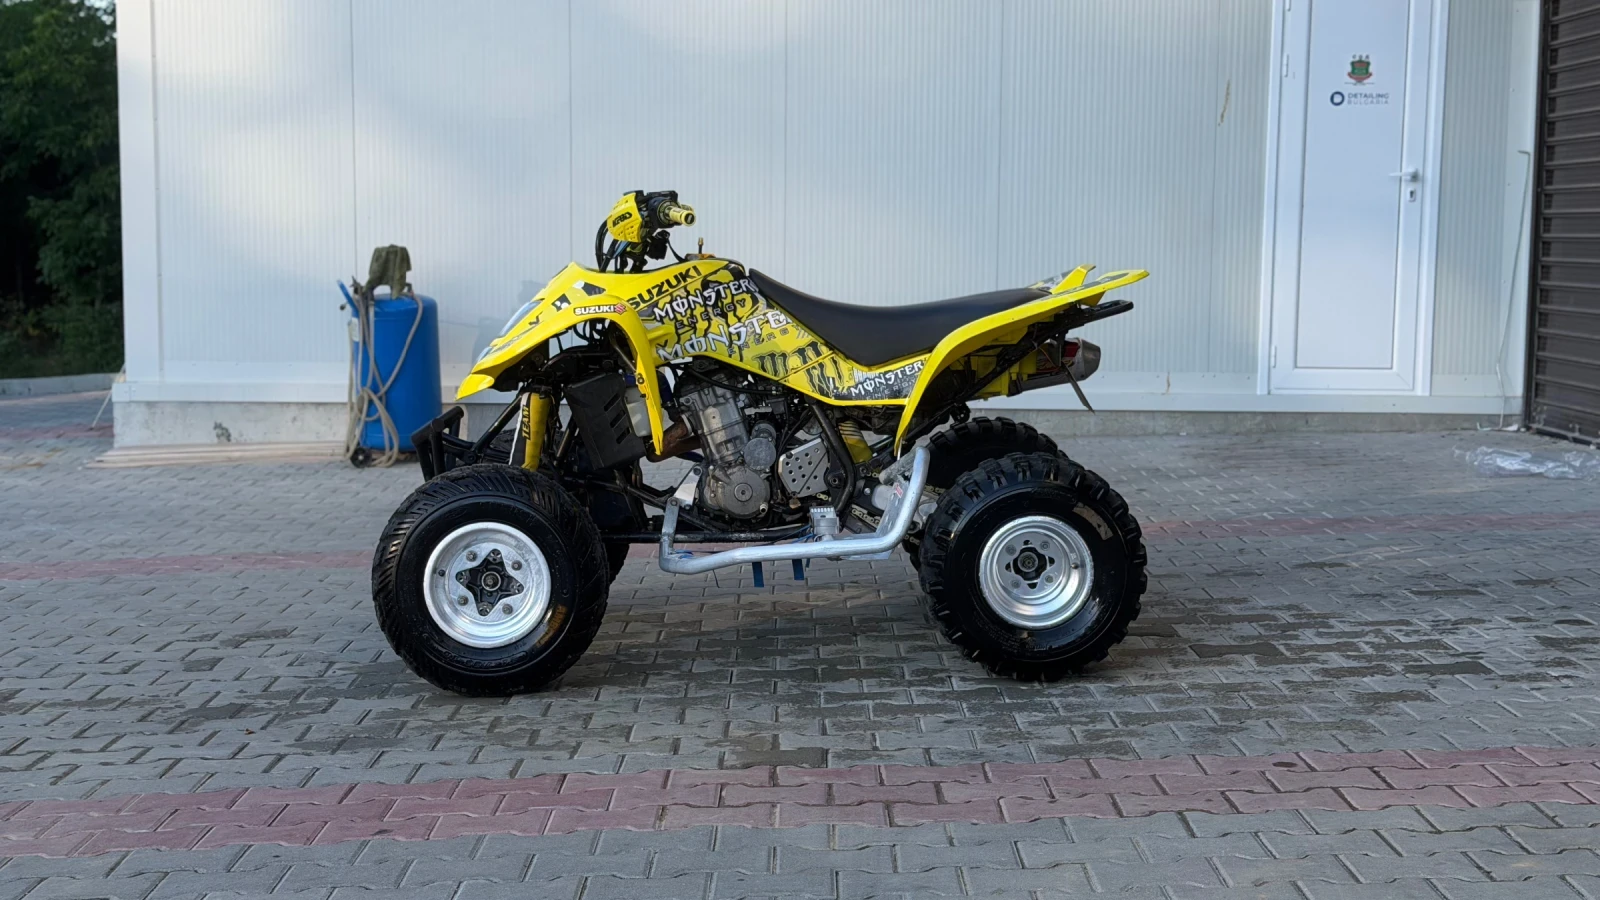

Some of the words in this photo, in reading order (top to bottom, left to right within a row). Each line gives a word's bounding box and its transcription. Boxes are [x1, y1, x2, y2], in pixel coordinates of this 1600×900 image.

[626, 265, 703, 309] SUZUKI
[653, 279, 757, 321] MONSTER
[574, 305, 614, 315] SUZUKI
[675, 297, 746, 330] ENERGY
[850, 360, 925, 397] MONSTER
[521, 405, 531, 441] TEAM
